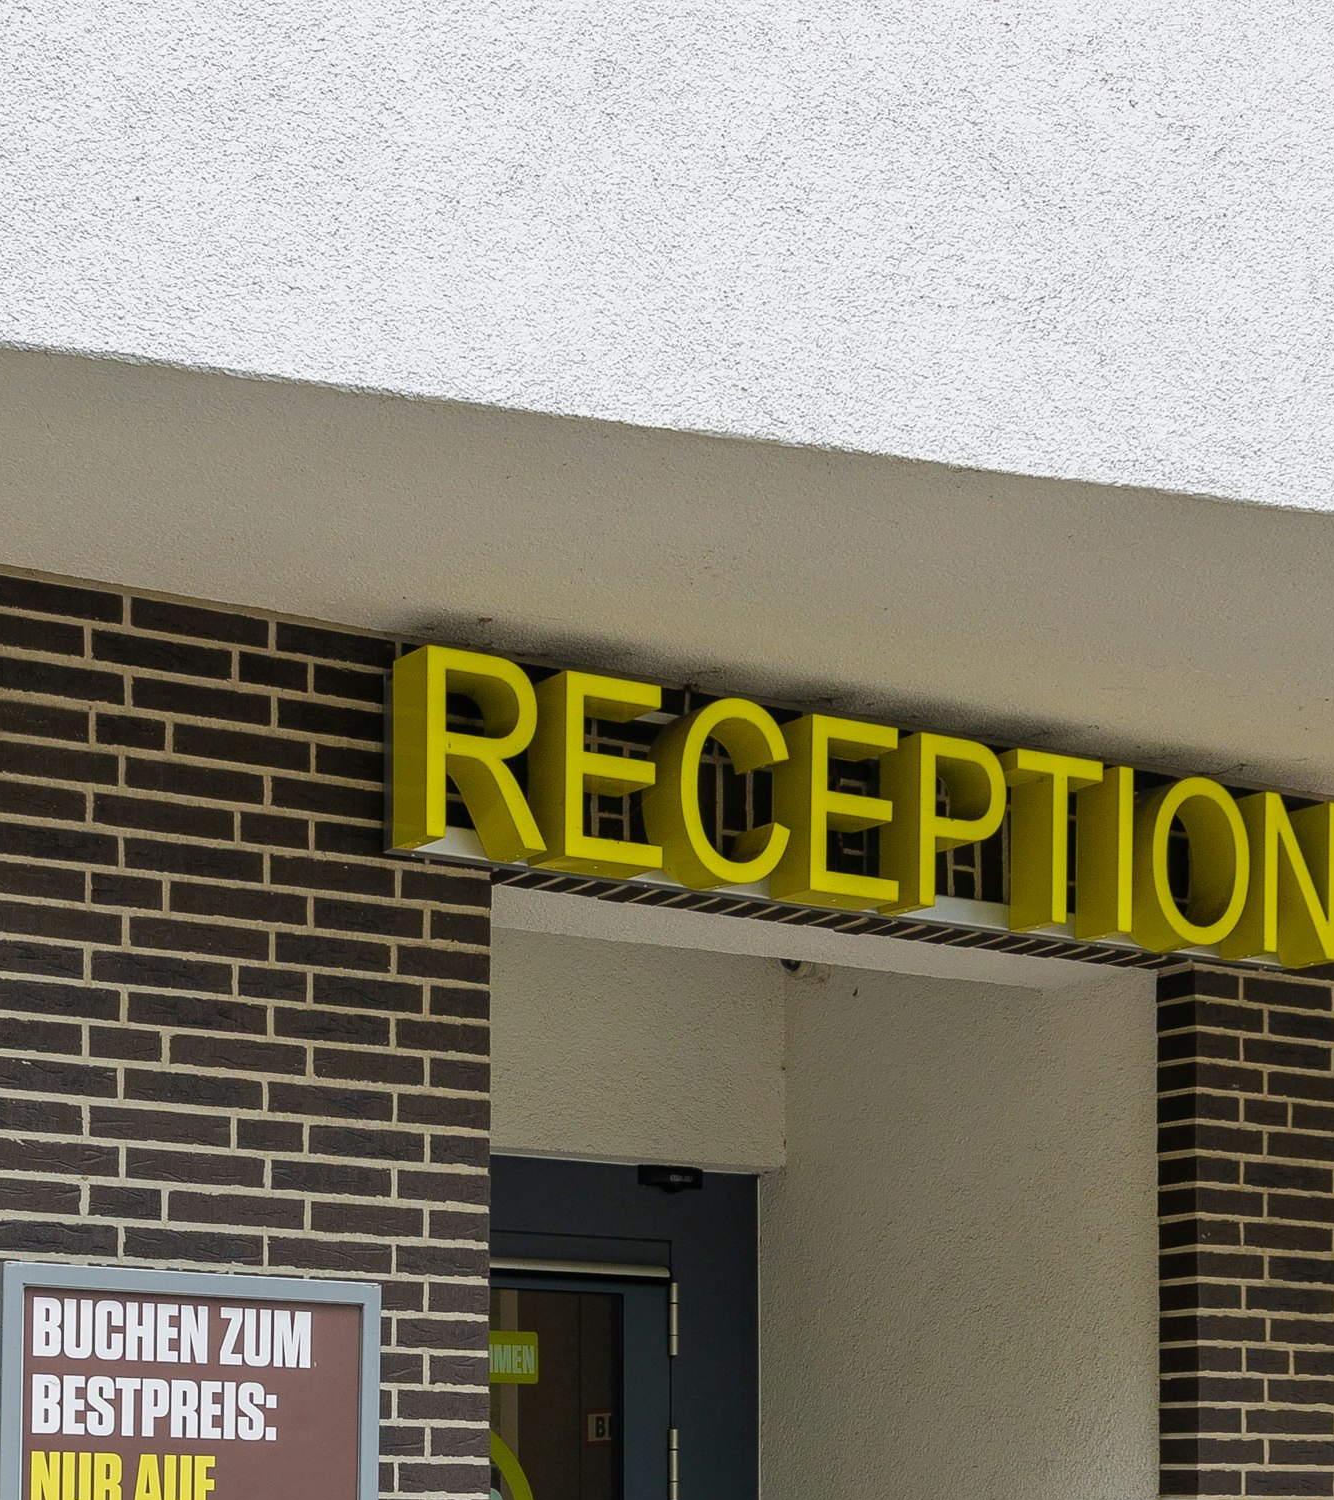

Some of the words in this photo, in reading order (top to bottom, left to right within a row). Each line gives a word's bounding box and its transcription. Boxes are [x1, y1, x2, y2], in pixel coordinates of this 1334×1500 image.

[31, 1296, 209, 1365] BUCHEN
[218, 1306, 313, 1369] ZUM
[30, 1373, 278, 1441] BESTPREIS:
